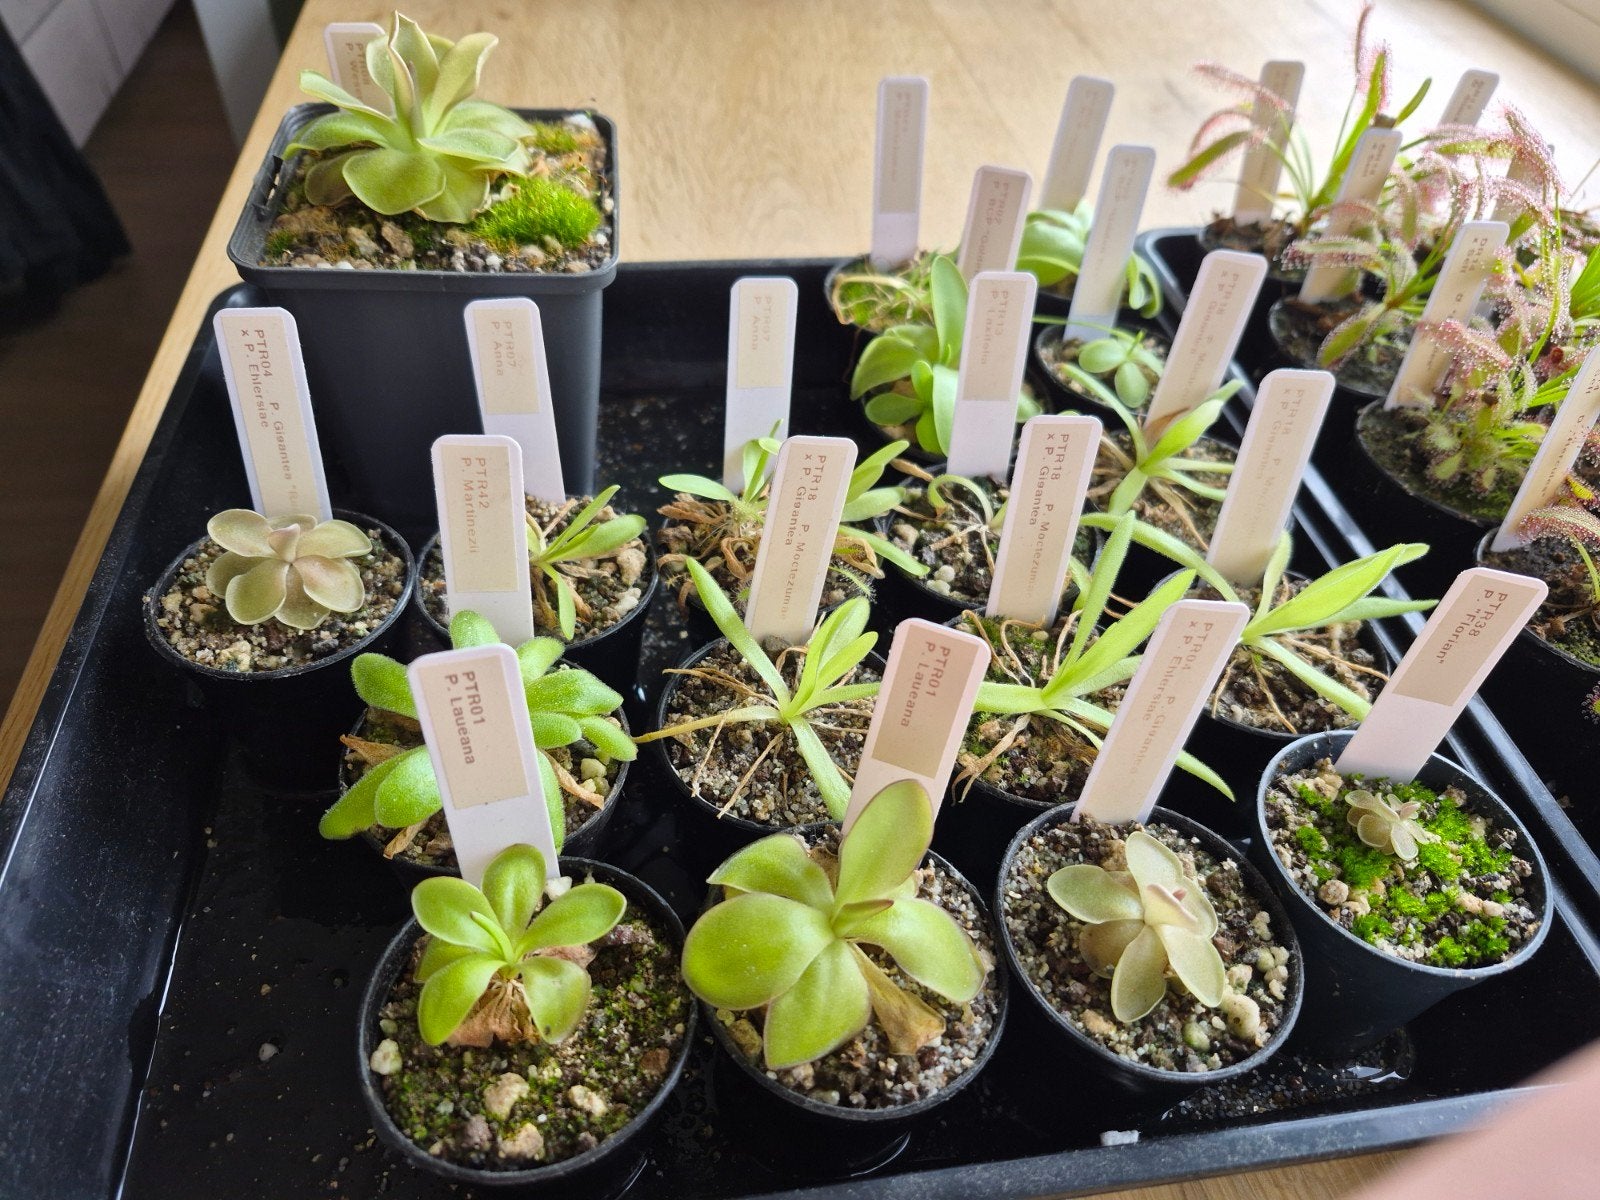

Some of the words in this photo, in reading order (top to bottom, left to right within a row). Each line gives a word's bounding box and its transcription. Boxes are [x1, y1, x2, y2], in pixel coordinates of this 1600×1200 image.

[243, 343, 254, 357] P.
[253, 329, 272, 377] PTR04
[493, 340, 503, 376] Anna
[501, 320, 516, 367] PTR07
[248, 364, 270, 428] Ehlersiae
[268, 402, 280, 414] P.
[272, 420, 293, 479] Gigantea
[460, 457, 471, 472] P.
[804, 453, 812, 461] x
[1042, 446, 1053, 461] P.
[1050, 433, 1069, 481] PTR18
[474, 457, 489, 509] PTR42
[799, 467, 810, 481] P.
[807, 455, 826, 501] PTR18
[1028, 466, 1049, 525] Gigantea
[462, 479, 479, 553] Martinezii
[784, 486, 806, 545] Gigantea
[798, 524, 809, 537] P.
[1042, 503, 1053, 517] P.
[1467, 591, 1508, 638] PTR38
[1475, 589, 1494, 605] P.
[921, 640, 935, 657] P.
[925, 645, 951, 697] PTR01
[444, 674, 459, 691] P.
[461, 670, 485, 724] PTR01
[900, 662, 928, 727] Laueana
[449, 697, 476, 764] Laueana
